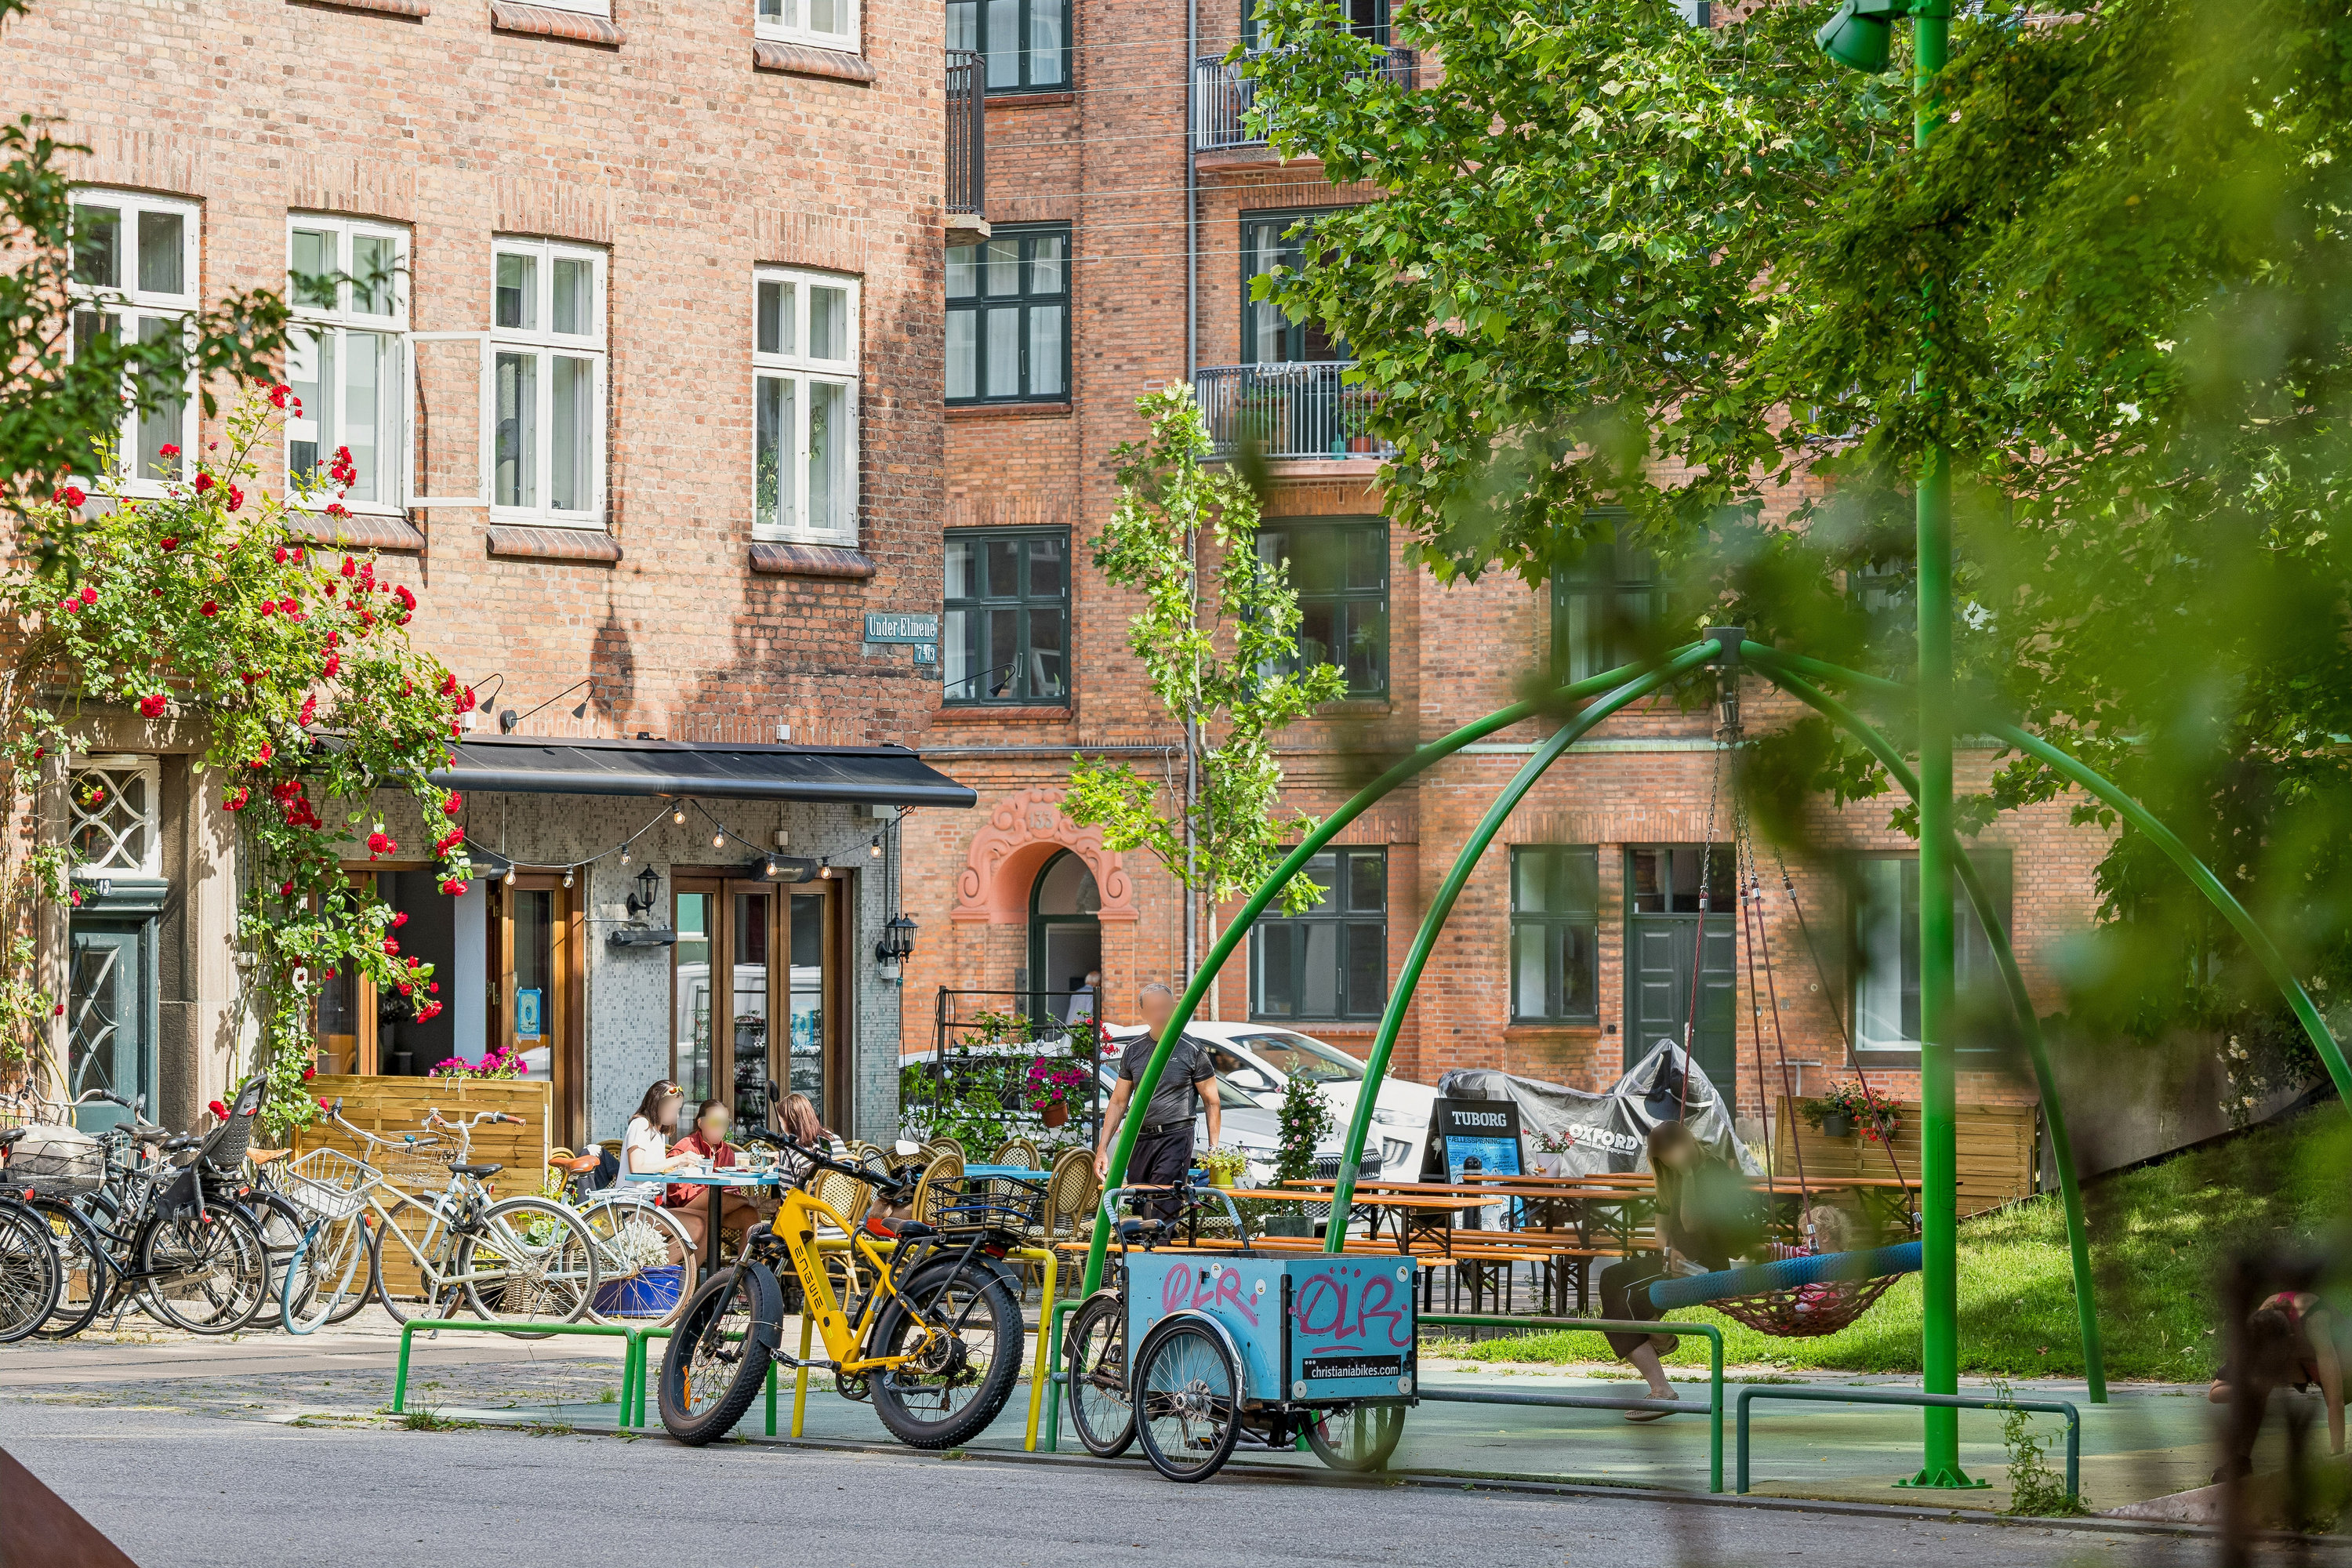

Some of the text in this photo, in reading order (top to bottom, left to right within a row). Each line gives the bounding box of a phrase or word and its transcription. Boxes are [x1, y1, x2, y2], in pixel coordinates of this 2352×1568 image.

[869, 617, 935, 637] Under Elmene
[917, 646, 935, 662] 7-13
[1029, 810, 1054, 829] 133
[99, 880, 111, 895] 13
[1451, 1110, 1508, 1127] TUBORG
[1447, 1136, 1501, 1145] FÆLLESSPISNING
[1569, 1123, 1639, 1150] OXFORD
[1606, 1145, 1635, 1156] Equipment
[1311, 1363, 1399, 1377] christianiabikes.com
